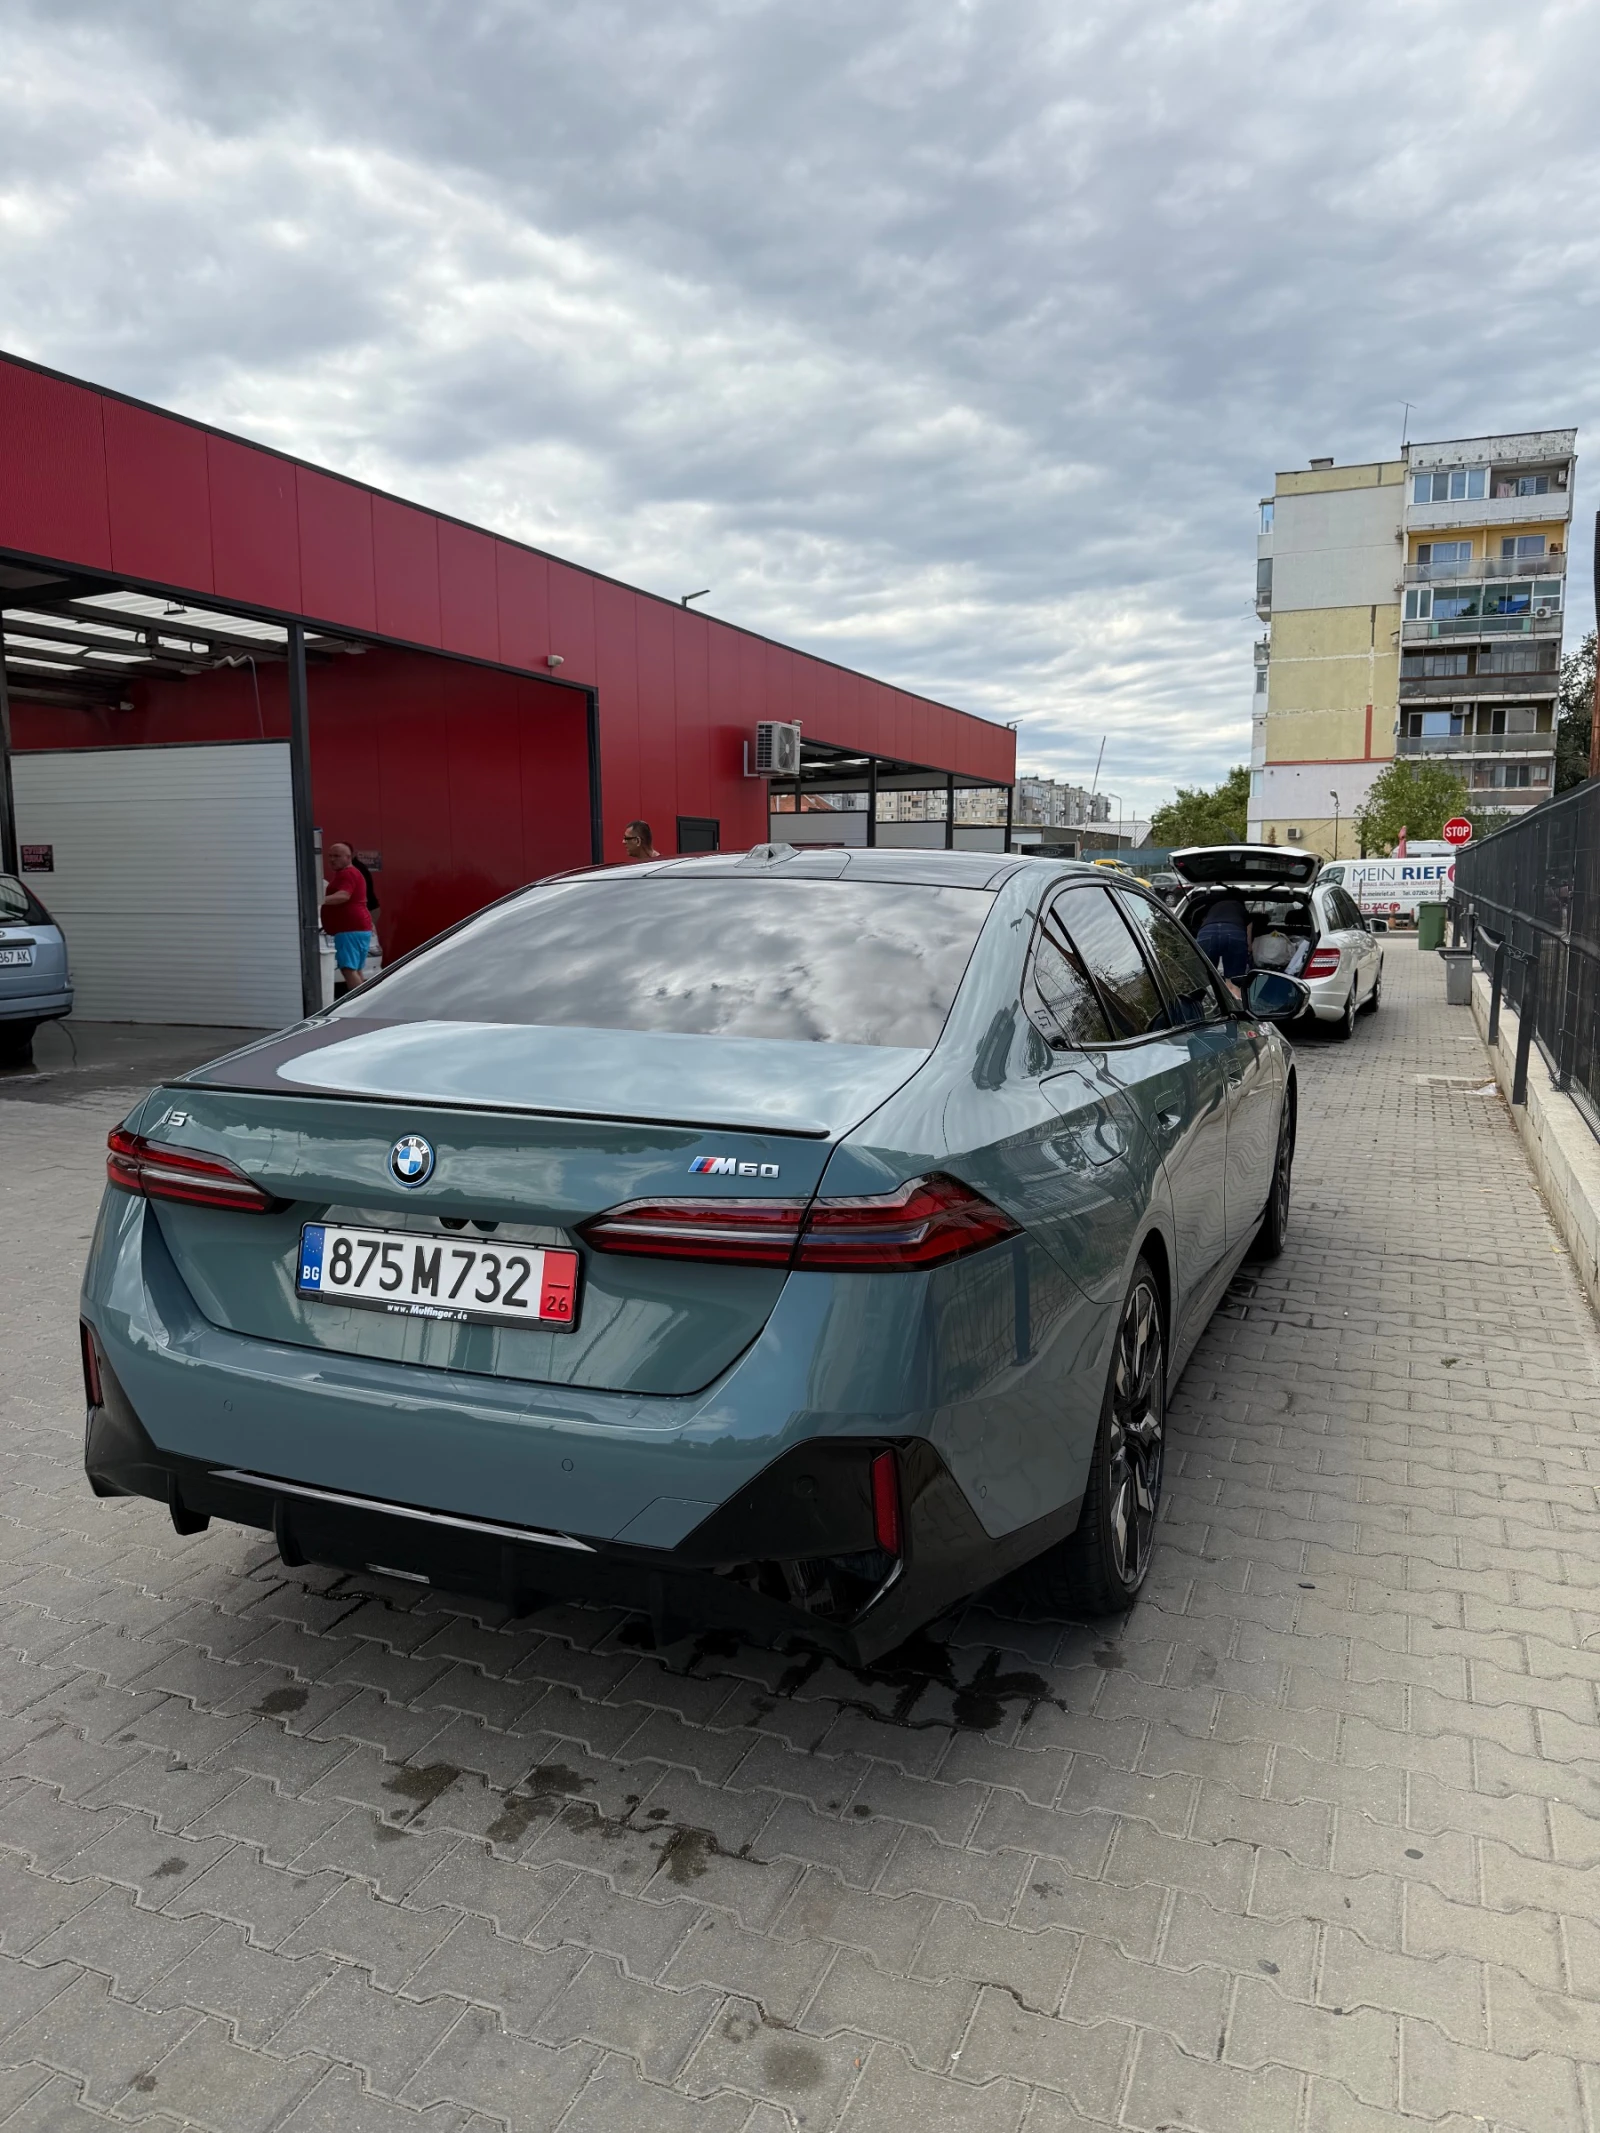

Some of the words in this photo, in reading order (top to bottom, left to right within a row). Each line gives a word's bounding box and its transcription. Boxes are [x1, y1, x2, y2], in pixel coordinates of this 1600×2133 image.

[1445, 826, 1470, 837] STOP
[1352, 867, 1395, 881] MEIN
[1402, 866, 1447, 880] RIEF
[1371, 902, 1389, 910] ZAC
[17, 950, 30, 962] AK
[395, 1138, 430, 1155] BMW
[708, 1156, 780, 1178] M60
[302, 1265, 320, 1281] BG
[328, 1237, 404, 1292] 875
[411, 1245, 442, 1297] M
[448, 1250, 532, 1308] 732
[546, 1295, 568, 1313] 26
